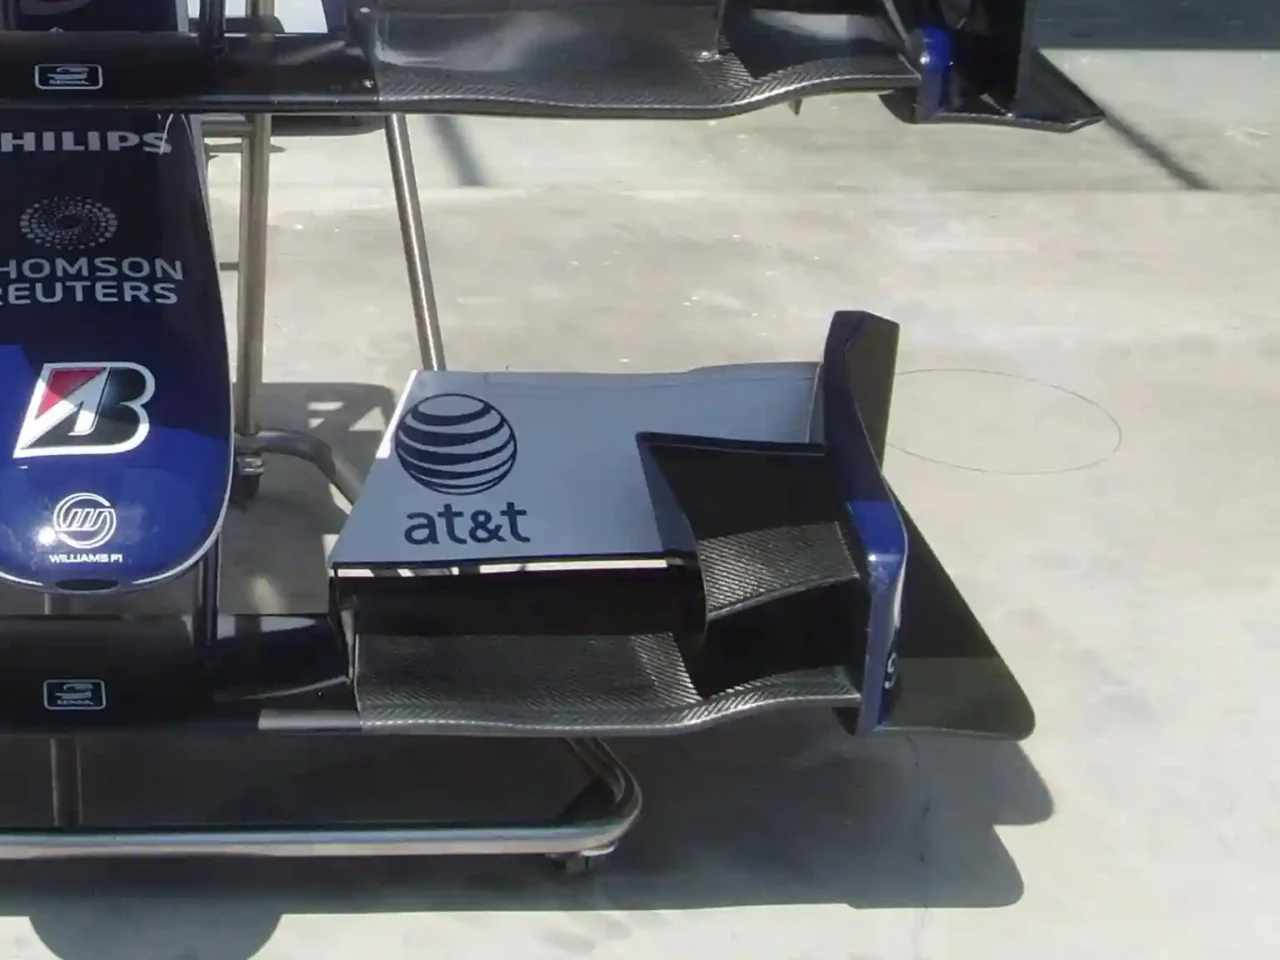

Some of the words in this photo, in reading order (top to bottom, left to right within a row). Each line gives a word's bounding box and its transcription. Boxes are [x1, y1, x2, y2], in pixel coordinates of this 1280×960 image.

[404, 501, 531, 546] at&t
[48, 553, 109, 564] WILLIAMS
[110, 553, 123, 564] F1
